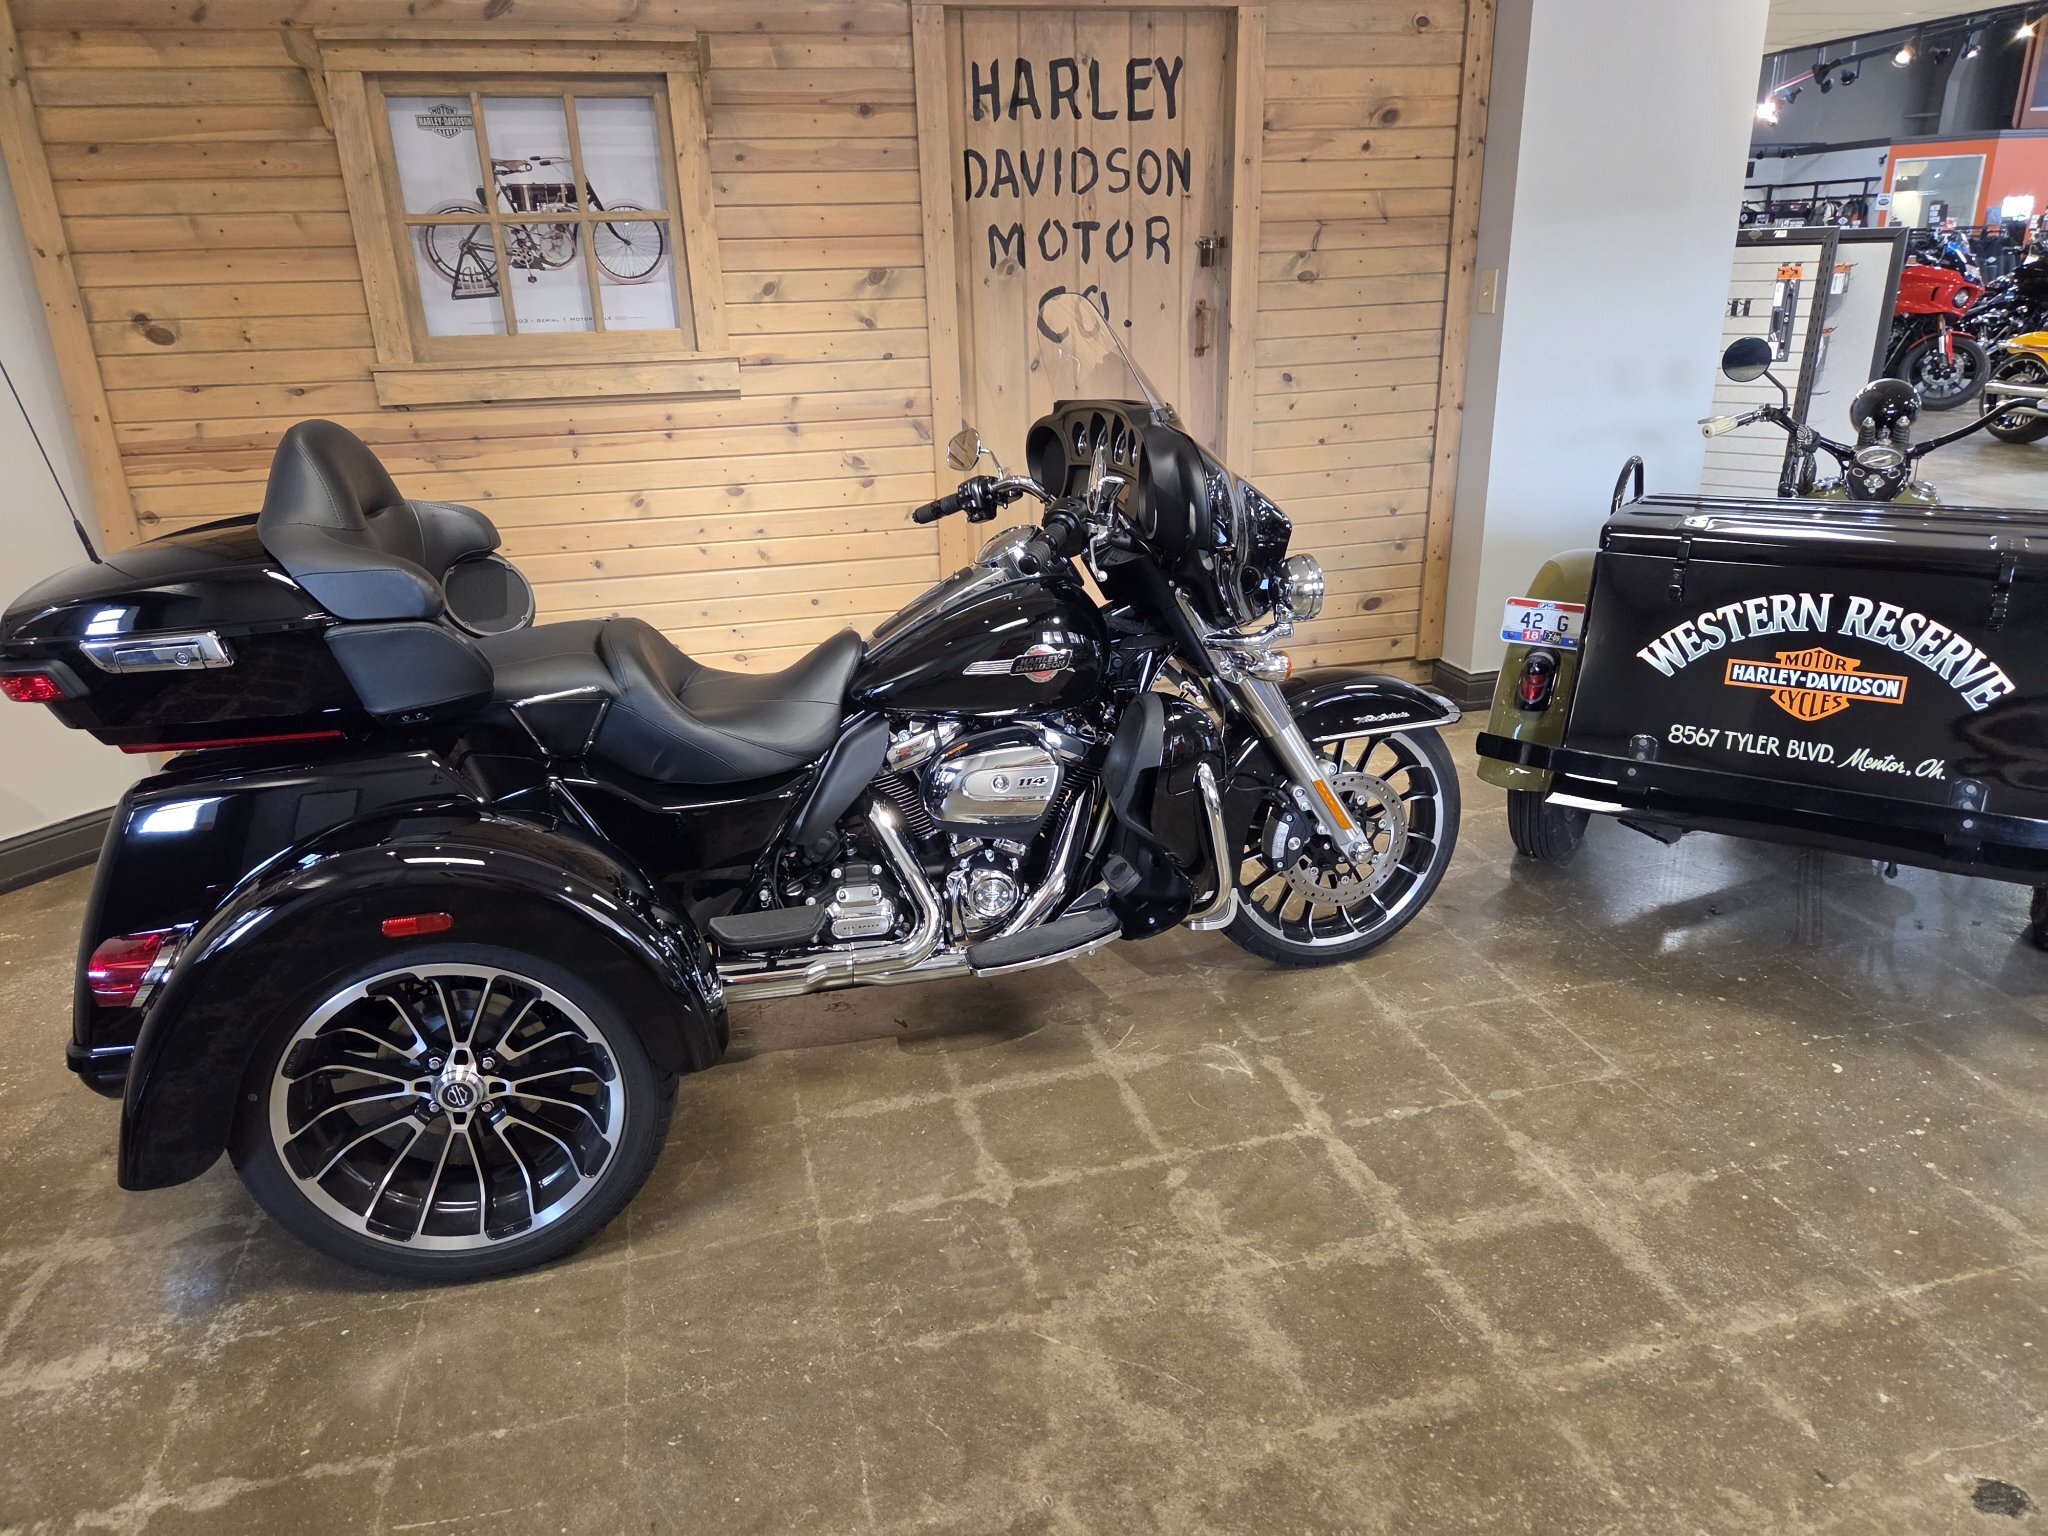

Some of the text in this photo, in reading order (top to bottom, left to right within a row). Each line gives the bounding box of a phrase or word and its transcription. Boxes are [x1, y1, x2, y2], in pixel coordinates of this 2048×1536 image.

[971, 56, 1184, 122] HARLEY
[418, 116, 472, 126] HARLEY-DAVIDSON
[431, 105, 455, 115] MOTOR
[436, 128, 459, 137] CYCLES
[963, 147, 1191, 202] DAVIDSON
[987, 215, 1170, 269] MOTOR
[1520, 611, 1569, 632] 42 G
[1524, 630, 1540, 641] 18
[1636, 593, 2018, 711] WESTERN RESERVE
[1784, 649, 1847, 672] MOTOR
[1014, 659, 1066, 672] DAVIDSON
[1731, 664, 1900, 698] HARLEY-DAVIDSON
[1778, 689, 1843, 718] CYCLES
[1667, 723, 1947, 780] 8567 TYLER BLVD. Mentor, Oh.
[1018, 776, 1049, 787] 114
